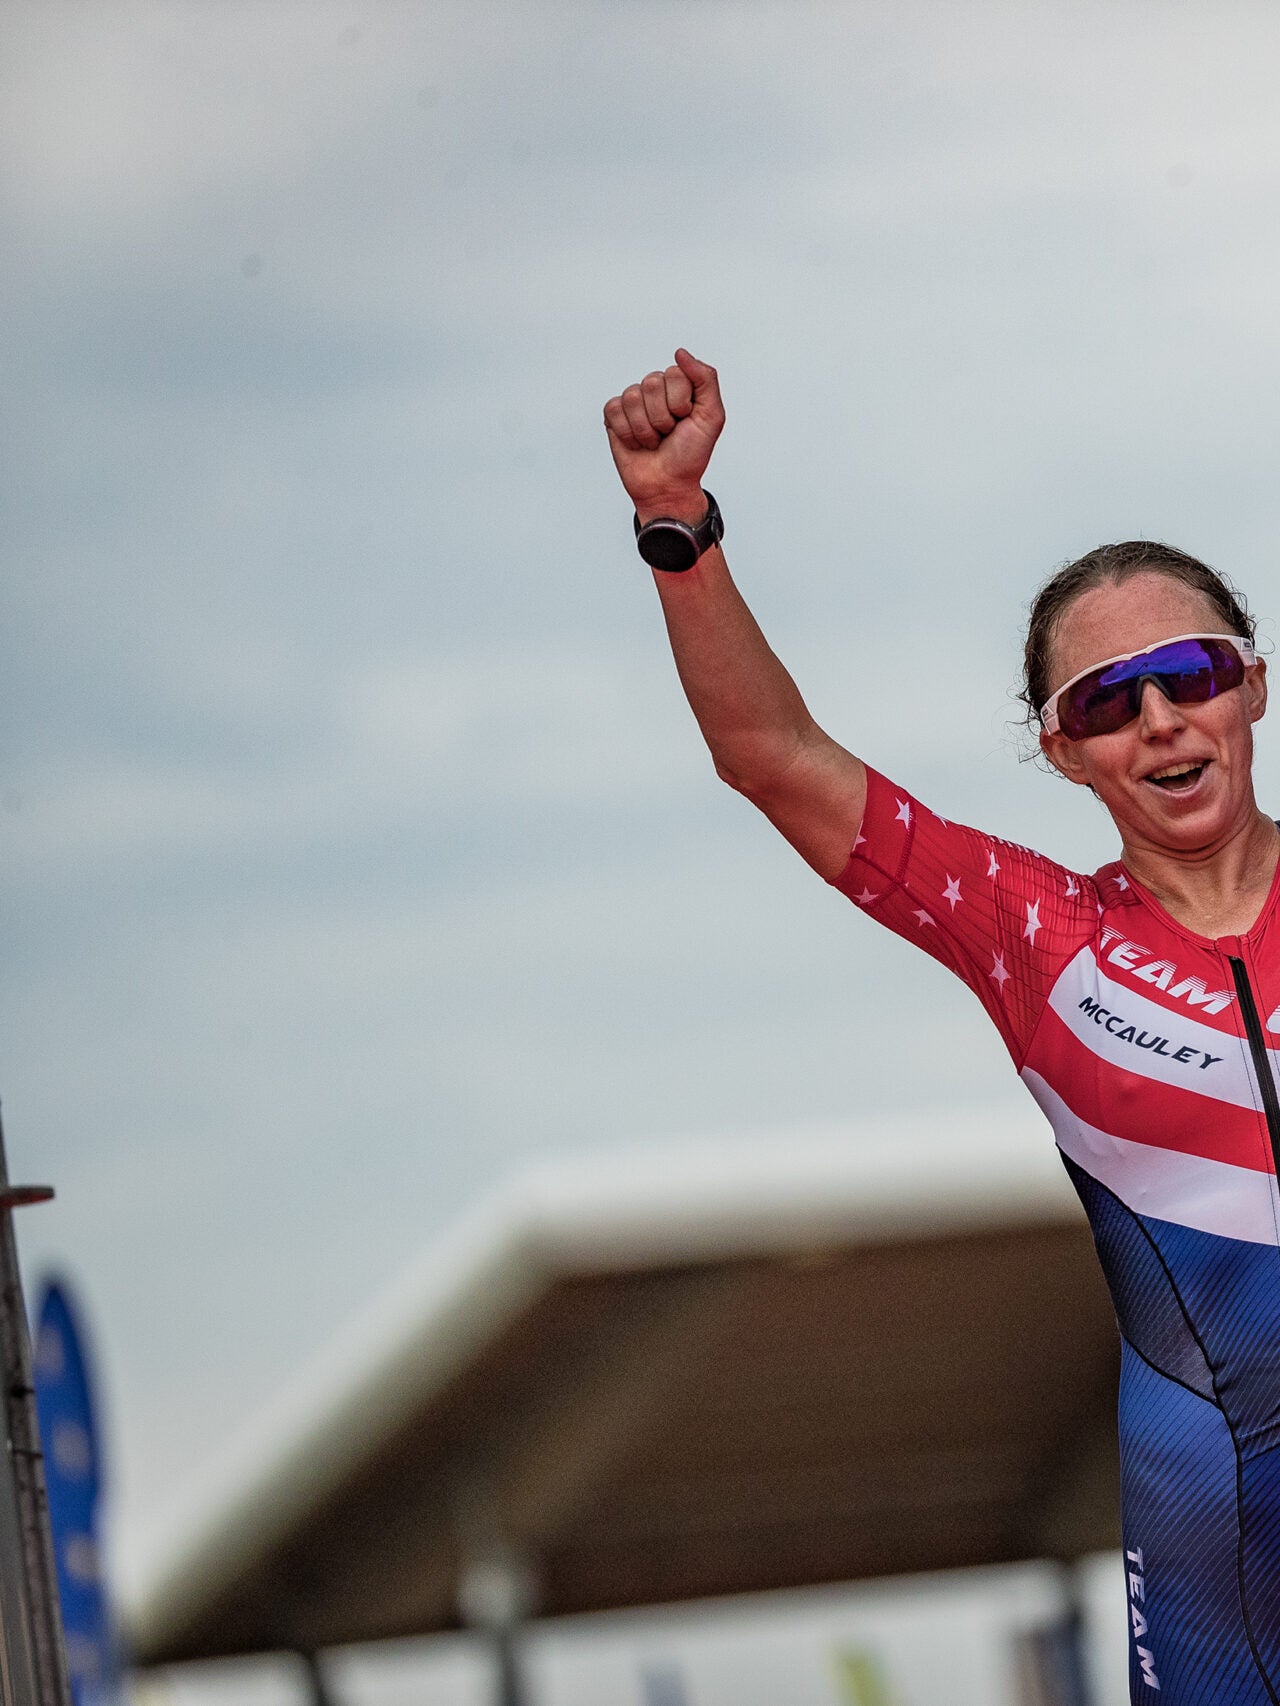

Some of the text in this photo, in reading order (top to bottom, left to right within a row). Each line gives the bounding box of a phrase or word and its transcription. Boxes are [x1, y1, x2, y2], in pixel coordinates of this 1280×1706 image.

[1100, 924, 1238, 1015] TEAM
[1078, 996, 1224, 1069] MCCAULEY
[1127, 1546, 1161, 1691] TEAM
